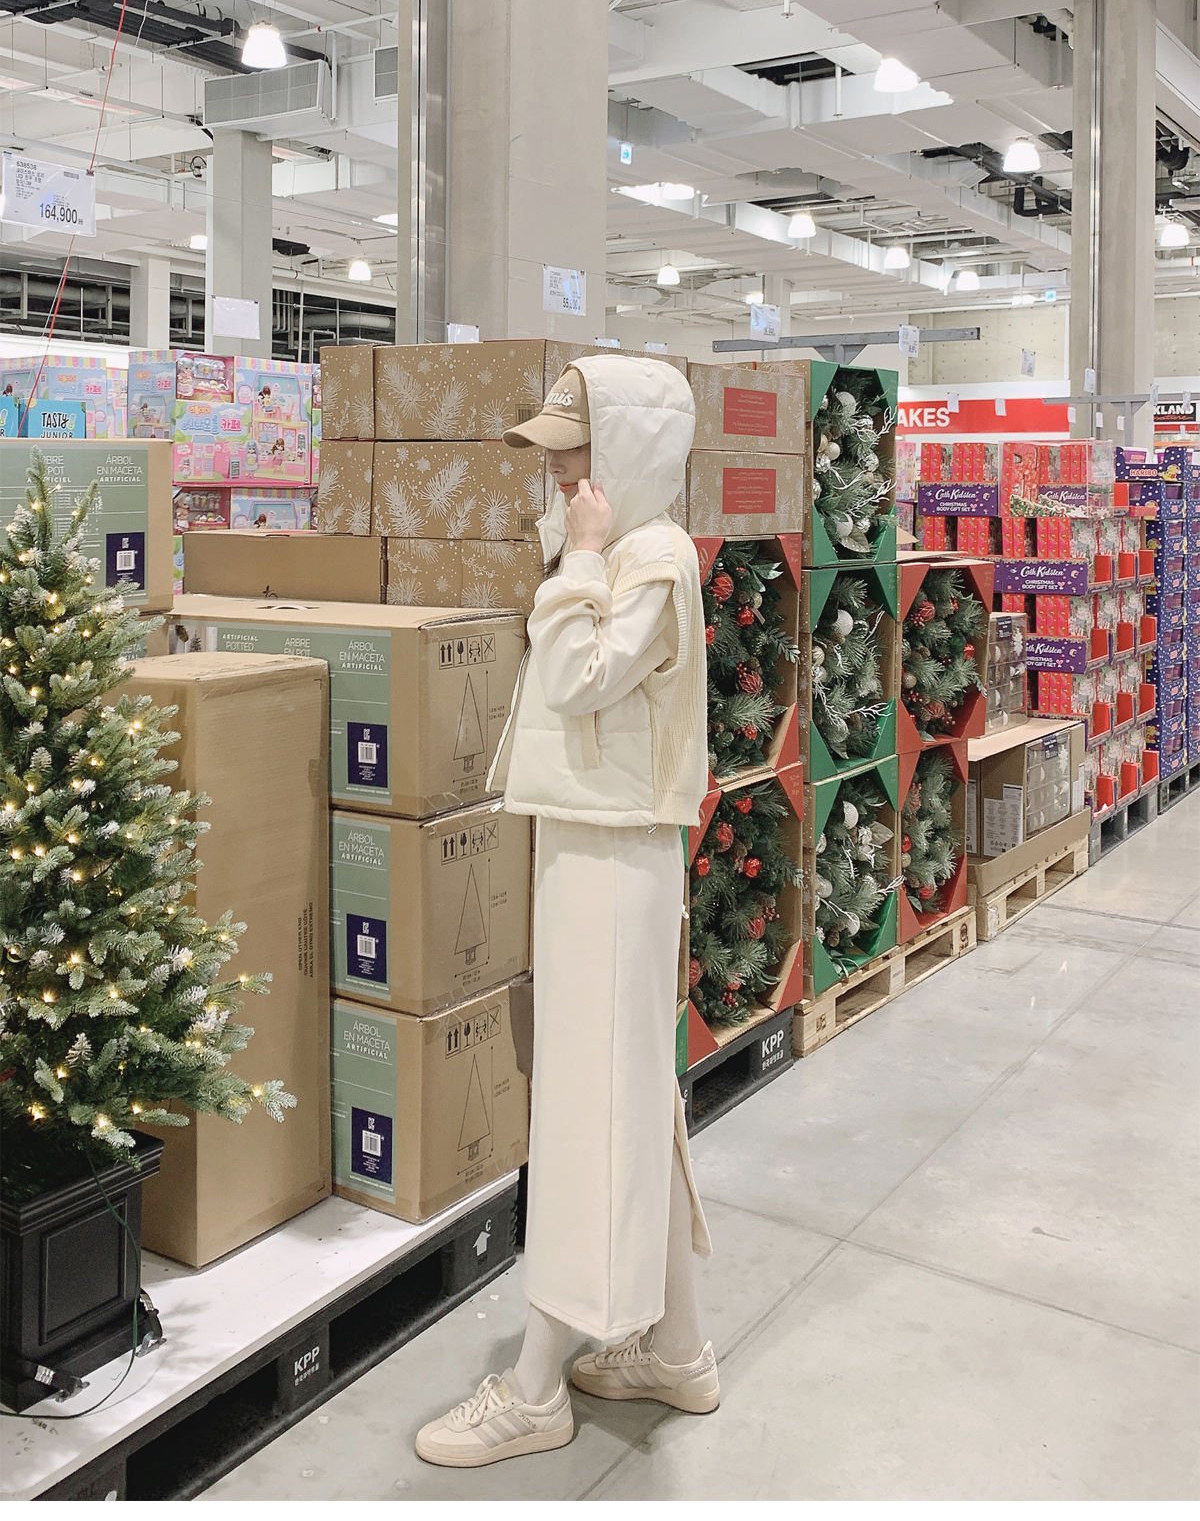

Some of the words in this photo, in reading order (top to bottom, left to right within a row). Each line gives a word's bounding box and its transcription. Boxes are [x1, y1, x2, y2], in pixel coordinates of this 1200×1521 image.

[16, 160, 37, 171] 638538
[898, 407, 950, 428] AKES
[220, 417, 242, 432] 카페
[105, 453, 134, 464] ÁRBOL
[48, 466, 64, 475] POT
[97, 466, 108, 475] EN
[110, 466, 142, 475] MACETA
[1130, 469, 1158, 477] HARIBO
[935, 489, 950, 500] Cath
[1020, 566, 1036, 577] Cath
[1036, 566, 1064, 577] Kidston
[222, 633, 258, 642] ARTIFICIAL
[284, 638, 310, 648] ARBRE
[226, 641, 254, 652] POTTED
[348, 639, 376, 652] ÁRBOL
[339, 651, 350, 661] EN
[352, 652, 385, 663] MACETA
[342, 662, 382, 671] ARTIFICIAL
[347, 830, 375, 846] ÁRBOL
[338, 841, 350, 852] EN
[351, 843, 385, 858] MACETA
[341, 853, 382, 865] ARTIFICIAL
[353, 1020, 381, 1038] ÁRBOL
[343, 1030, 355, 1042] EN
[356, 1032, 390, 1052] MACETA
[346, 1043, 388, 1059] ARTIFICIAL
[294, 1346, 320, 1376] KPP
